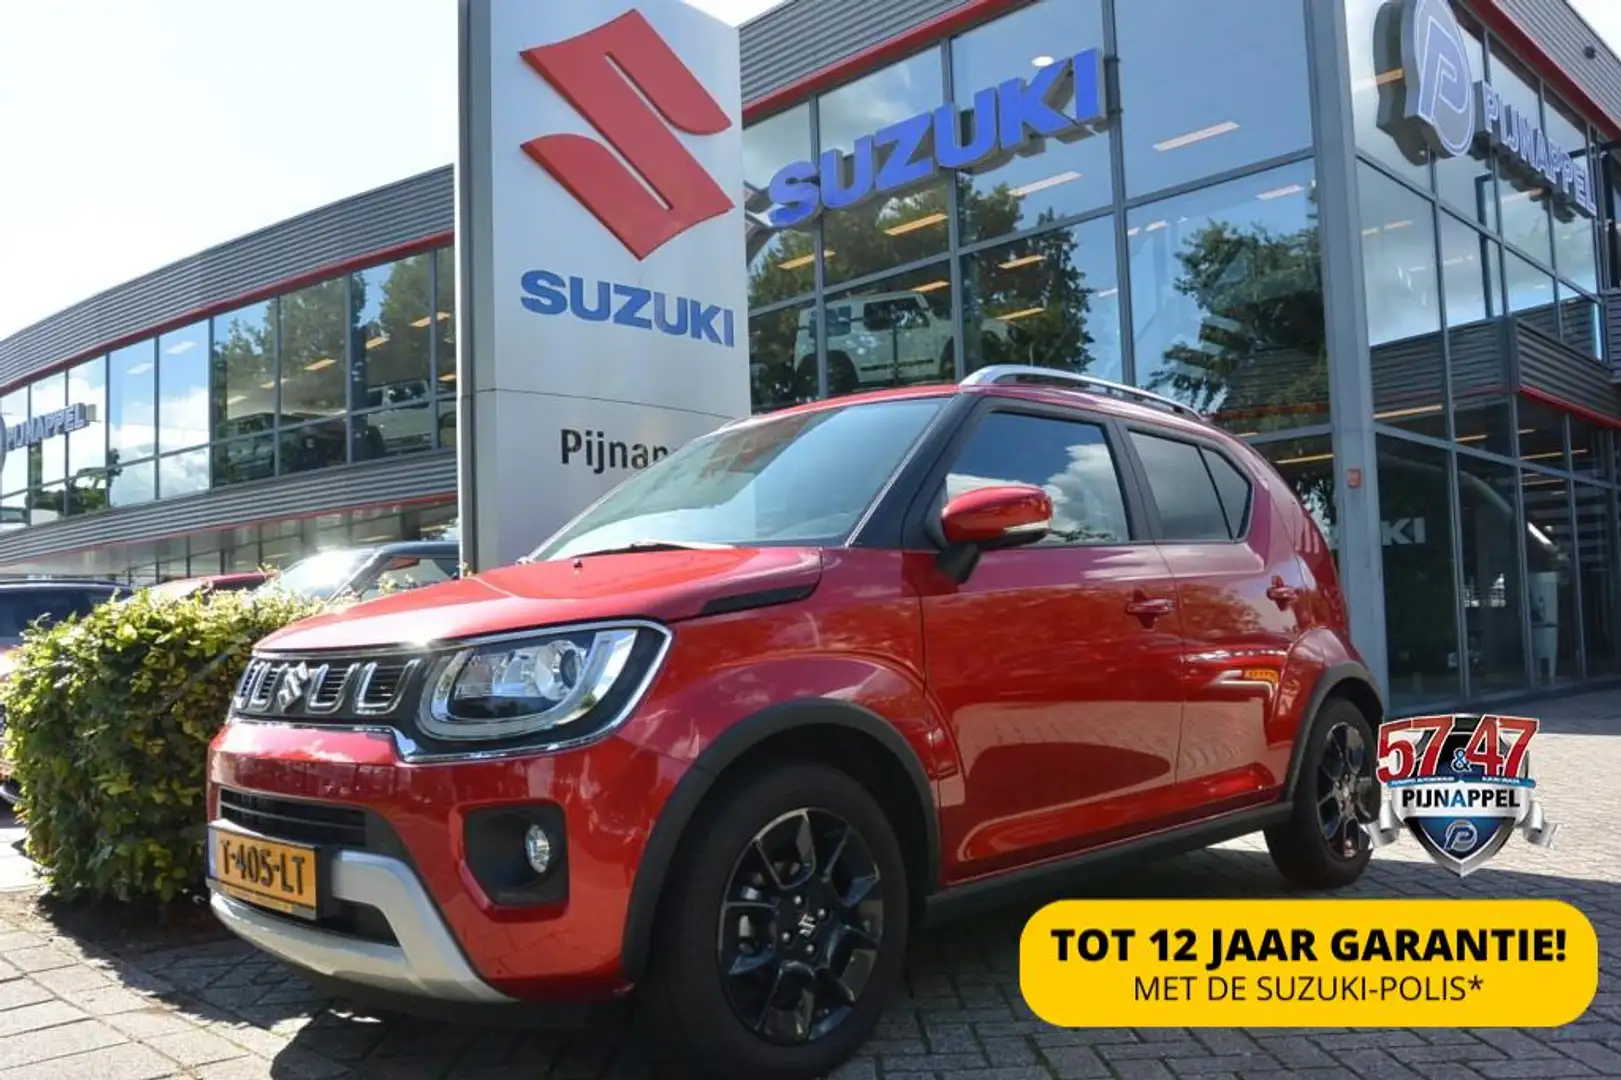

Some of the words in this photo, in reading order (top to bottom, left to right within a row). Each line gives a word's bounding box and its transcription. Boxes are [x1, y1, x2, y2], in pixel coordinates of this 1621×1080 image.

[767, 47, 1100, 227] SUZUKI
[1482, 80, 1597, 217] PIJNAPPEL
[520, 269, 735, 348] SUZUKI
[7, 403, 90, 452] PIJNAPPEL
